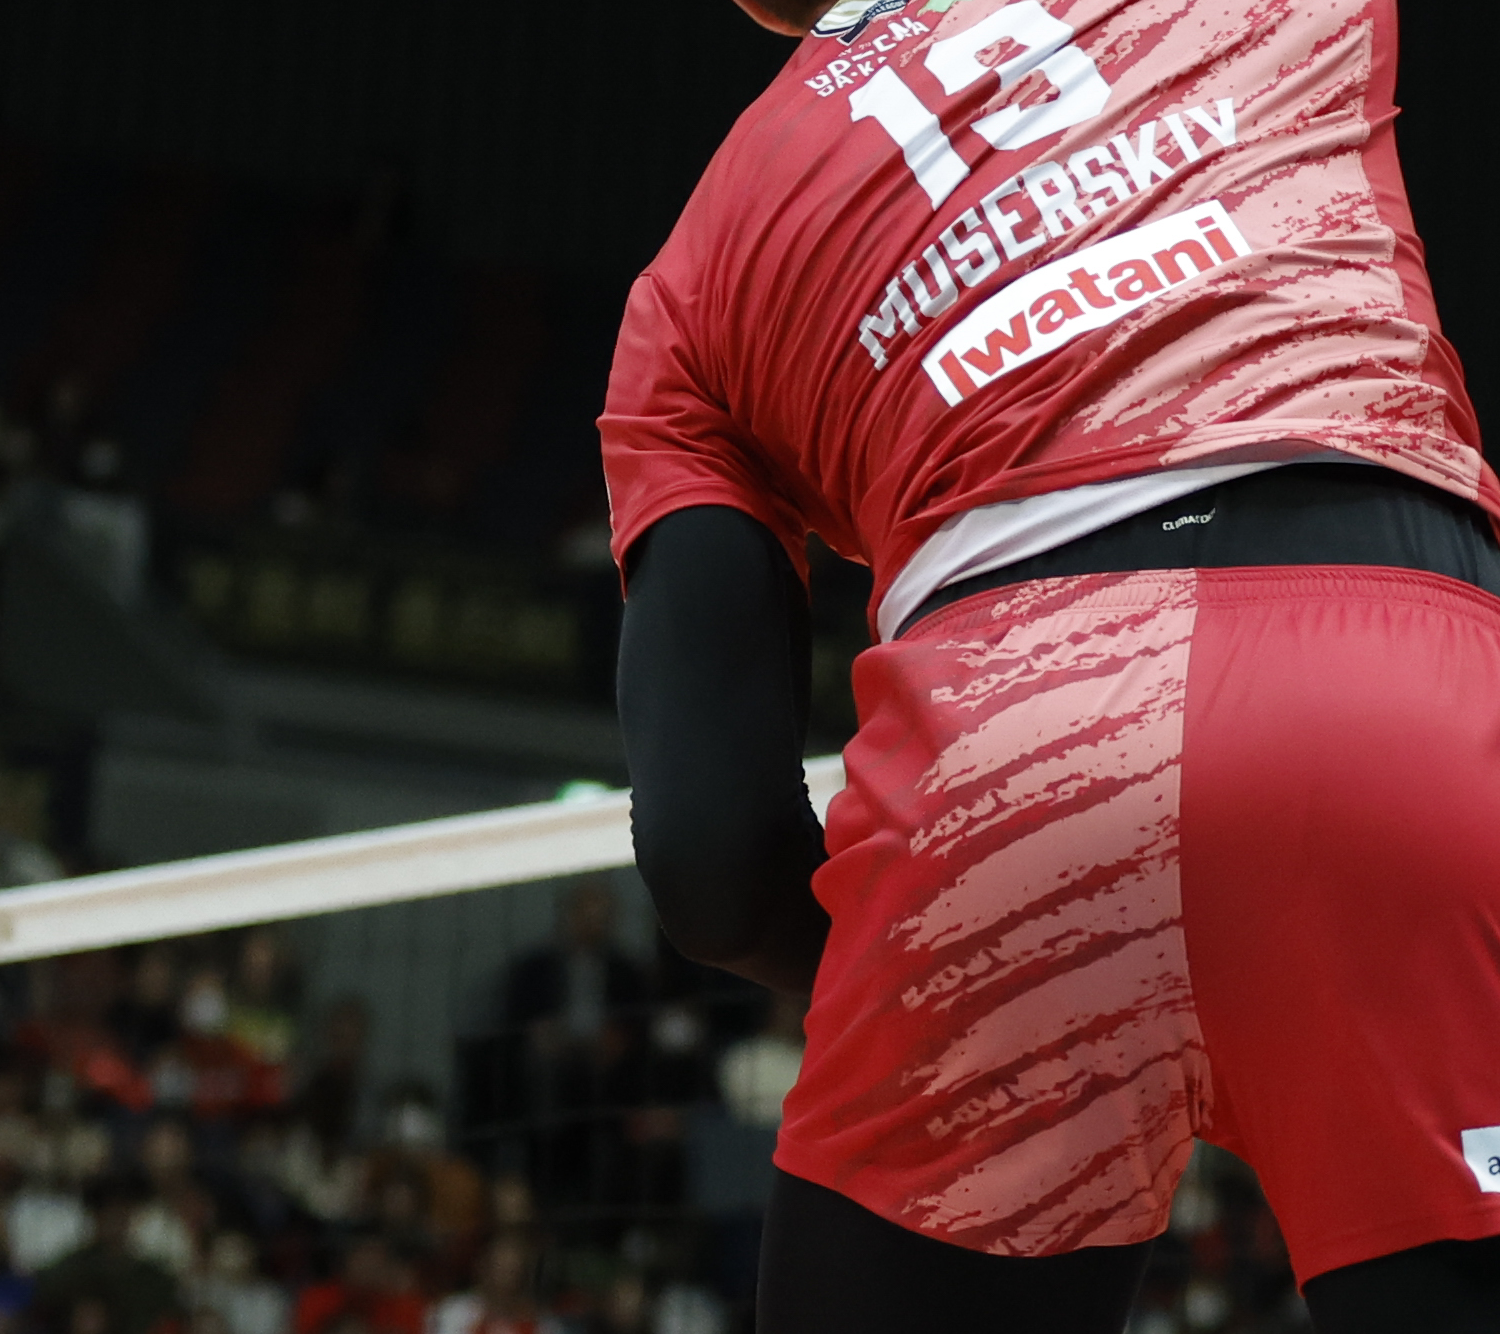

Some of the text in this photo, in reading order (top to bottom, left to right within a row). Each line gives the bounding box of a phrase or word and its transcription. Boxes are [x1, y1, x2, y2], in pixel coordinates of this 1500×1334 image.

[849, 0, 1113, 212] 13
[858, 97, 1238, 371] MUSERSKIY
[938, 215, 1239, 399] Iwatani
